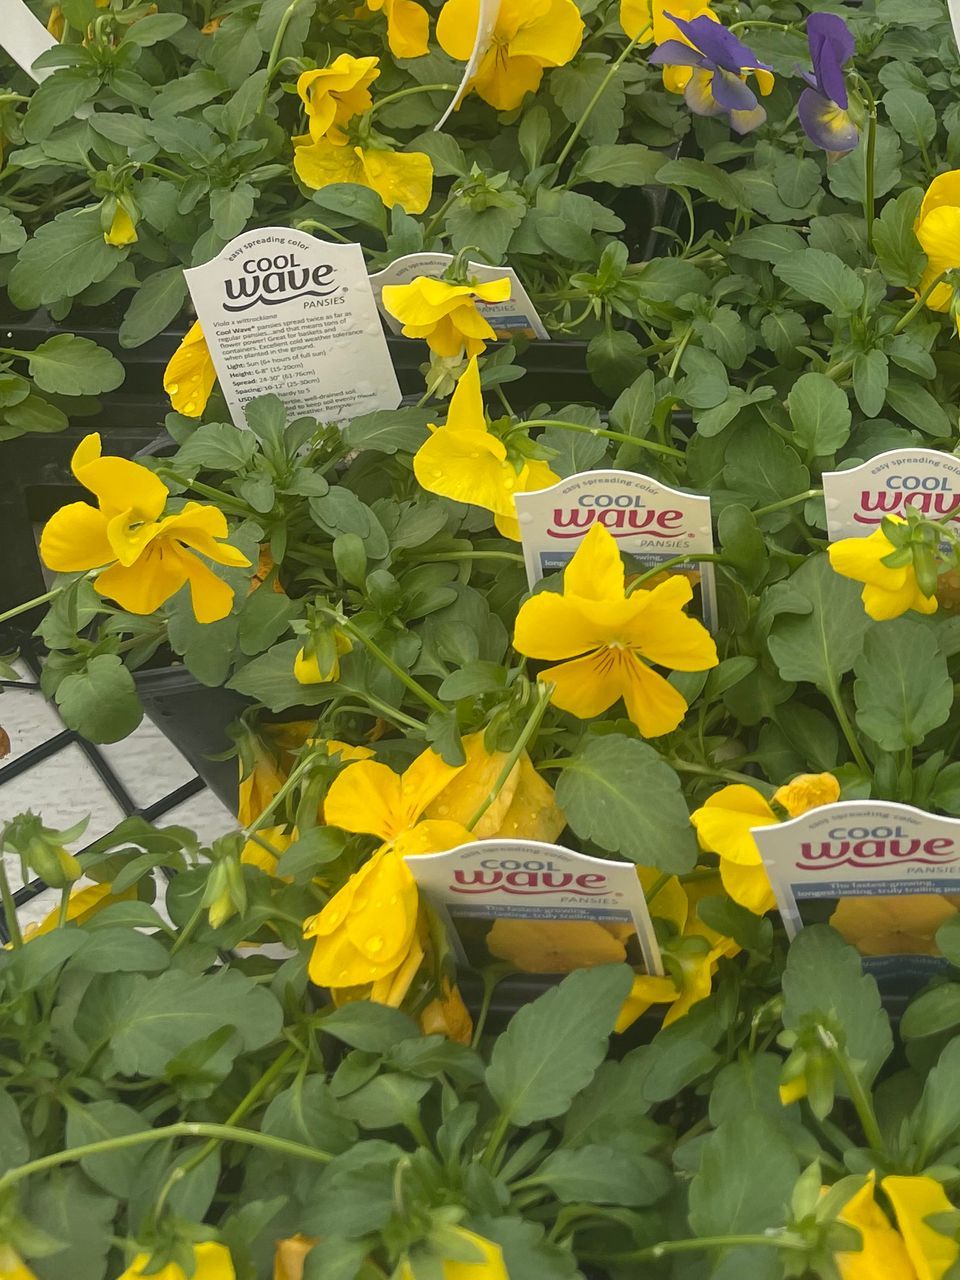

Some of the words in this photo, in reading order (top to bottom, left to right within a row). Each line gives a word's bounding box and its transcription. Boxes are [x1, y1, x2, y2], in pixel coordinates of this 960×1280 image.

[228, 246, 245, 262] easy
[243, 236, 286, 250] spreading
[287, 239, 310, 251] color
[243, 253, 301, 274] COOL
[224, 264, 338, 300] wave
[303, 296, 346, 310] PANSIES
[215, 328, 231, 336] Cool
[226, 362, 246, 370] Light:
[246, 360, 260, 368] Sun
[229, 369, 254, 378] Height:
[232, 378, 257, 387] Spread:
[871, 463, 891, 475] easy
[892, 456, 941, 467] spreading
[562, 483, 582, 495] easy
[582, 477, 634, 488] spreading
[634, 482, 660, 496] color
[886, 475, 953, 492] COOL
[577, 494, 647, 508] COOL
[553, 508, 684, 529] wave
[639, 539, 691, 549] PANSIES
[828, 826, 909, 840] COOL
[801, 837, 955, 860] wave
[480, 859, 561, 872] COOL
[453, 869, 608, 889] wave
[560, 896, 620, 905] PANSIES
